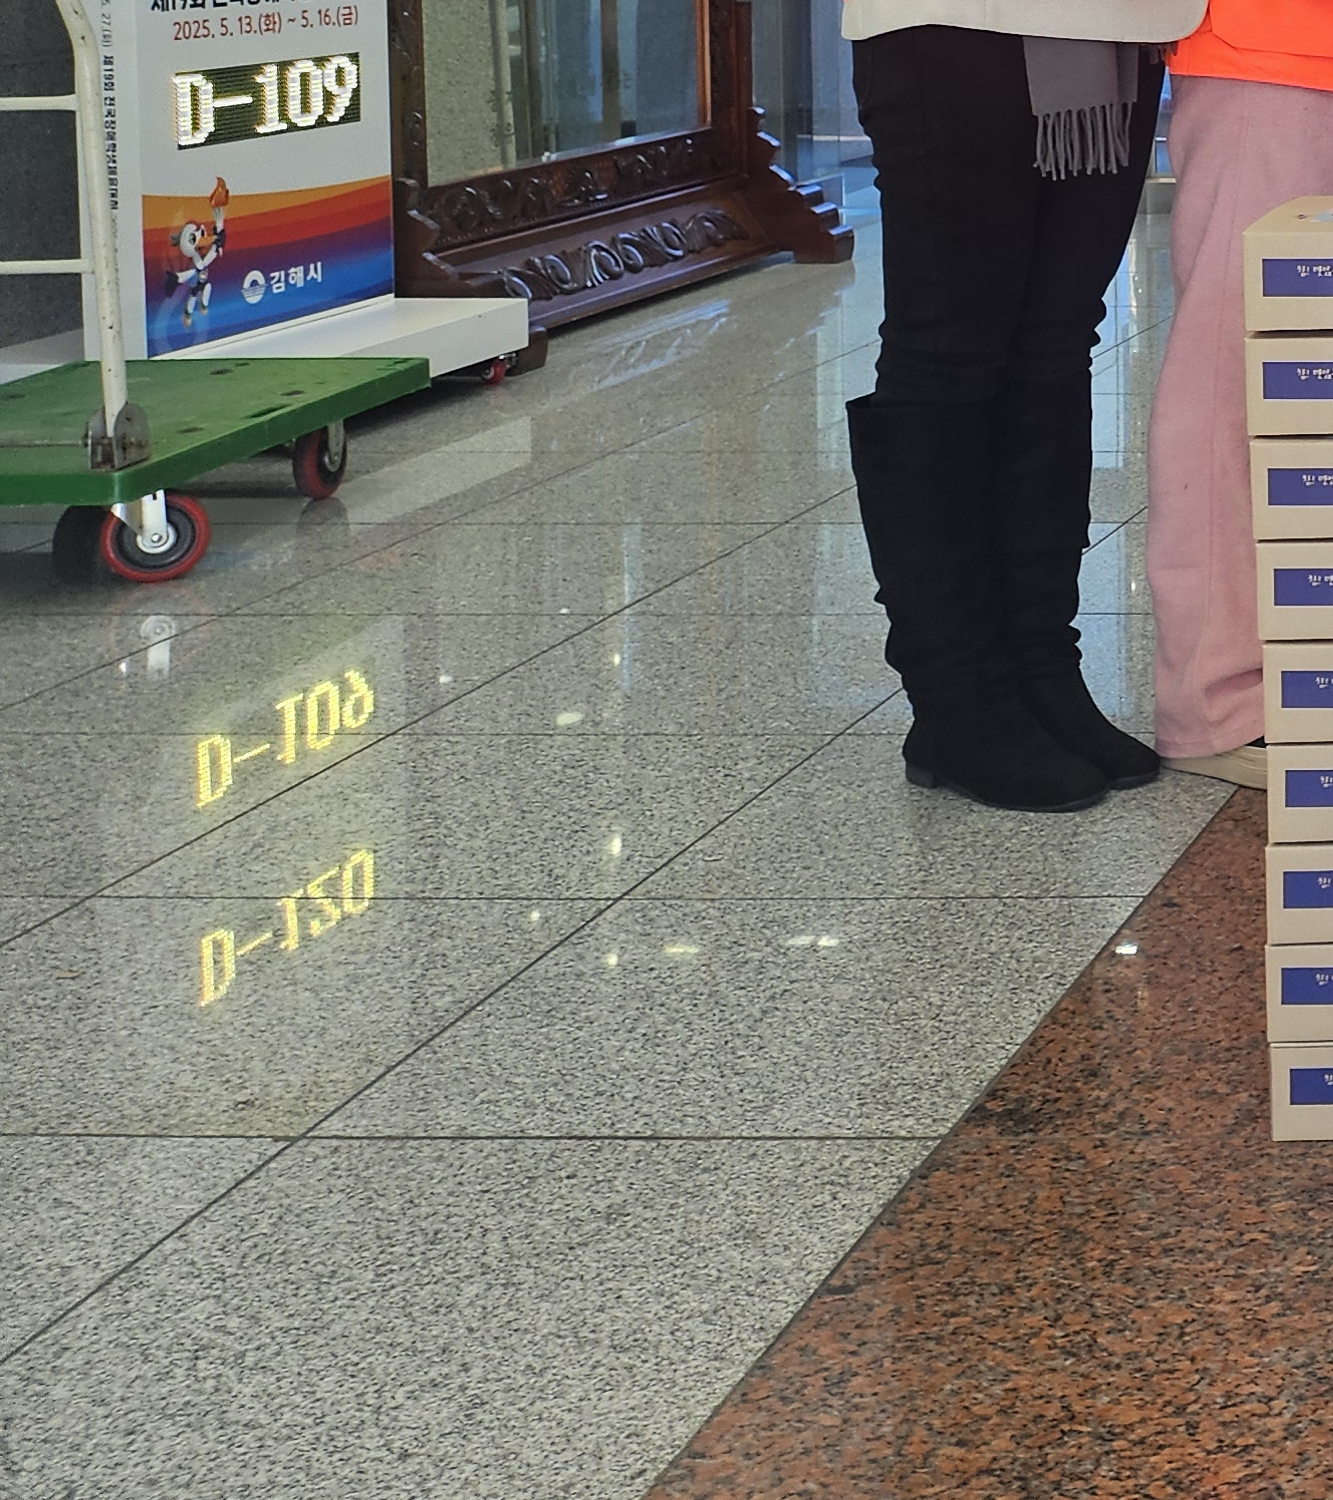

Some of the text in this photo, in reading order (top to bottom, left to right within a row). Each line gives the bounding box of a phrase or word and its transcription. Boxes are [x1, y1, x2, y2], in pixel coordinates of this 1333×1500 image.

[174, 21, 215, 40] 2025.
[220, 18, 233, 36] 5.
[238, 12, 281, 35] 13.(화)
[301, 10, 313, 28] 5.
[318, 6, 358, 27] 16.(금)
[173, 56, 358, 145] D-109
[270, 261, 322, 294] 김해시
